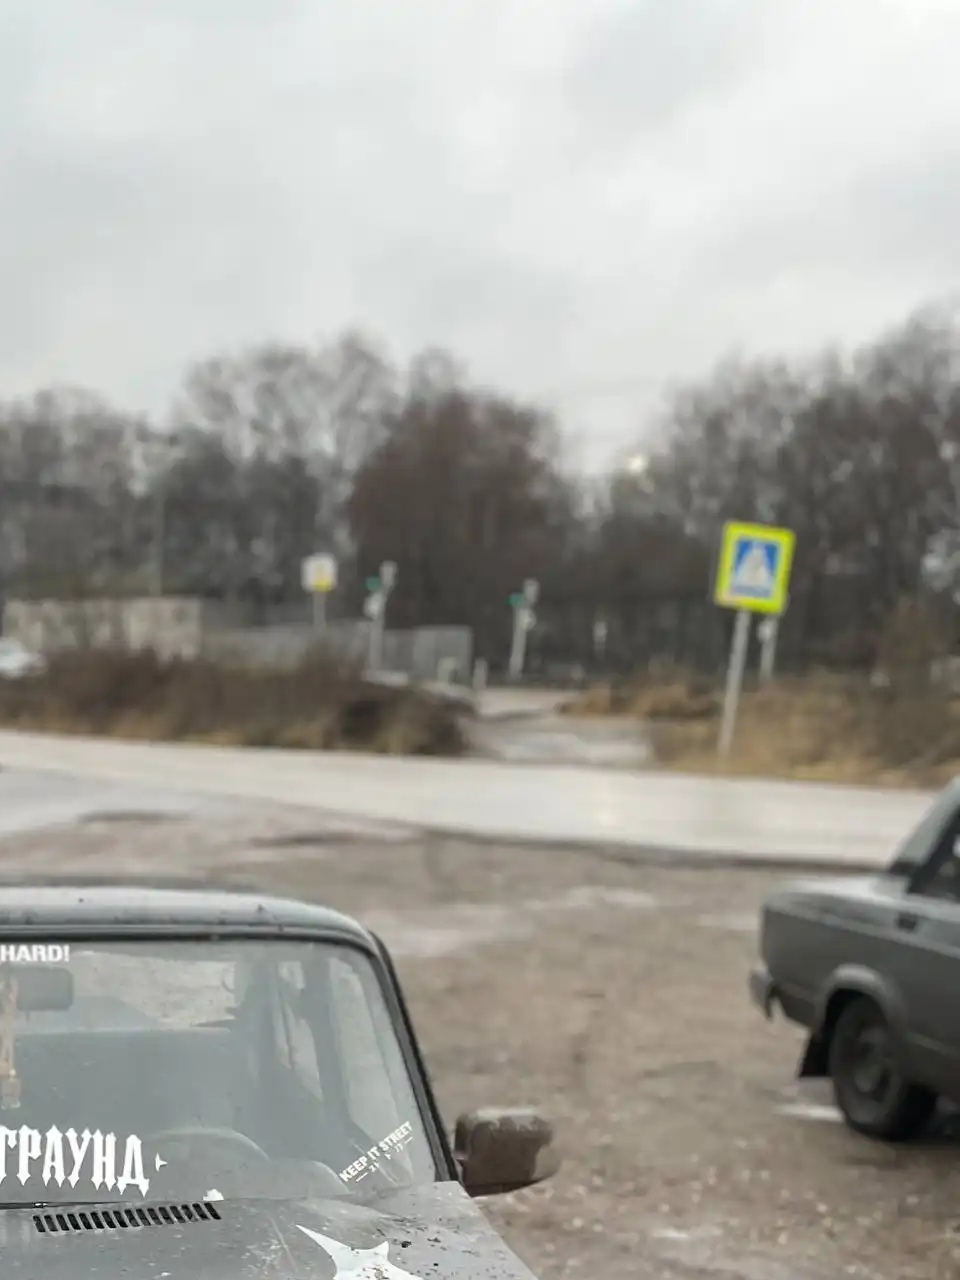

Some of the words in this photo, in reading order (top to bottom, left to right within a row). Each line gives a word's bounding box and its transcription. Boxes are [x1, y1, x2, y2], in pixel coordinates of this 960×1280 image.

[0, 943, 70, 963] HARD!
[339, 1156, 368, 1182] KEEP
[367, 1146, 380, 1160] IT
[379, 1121, 413, 1151] STREET
